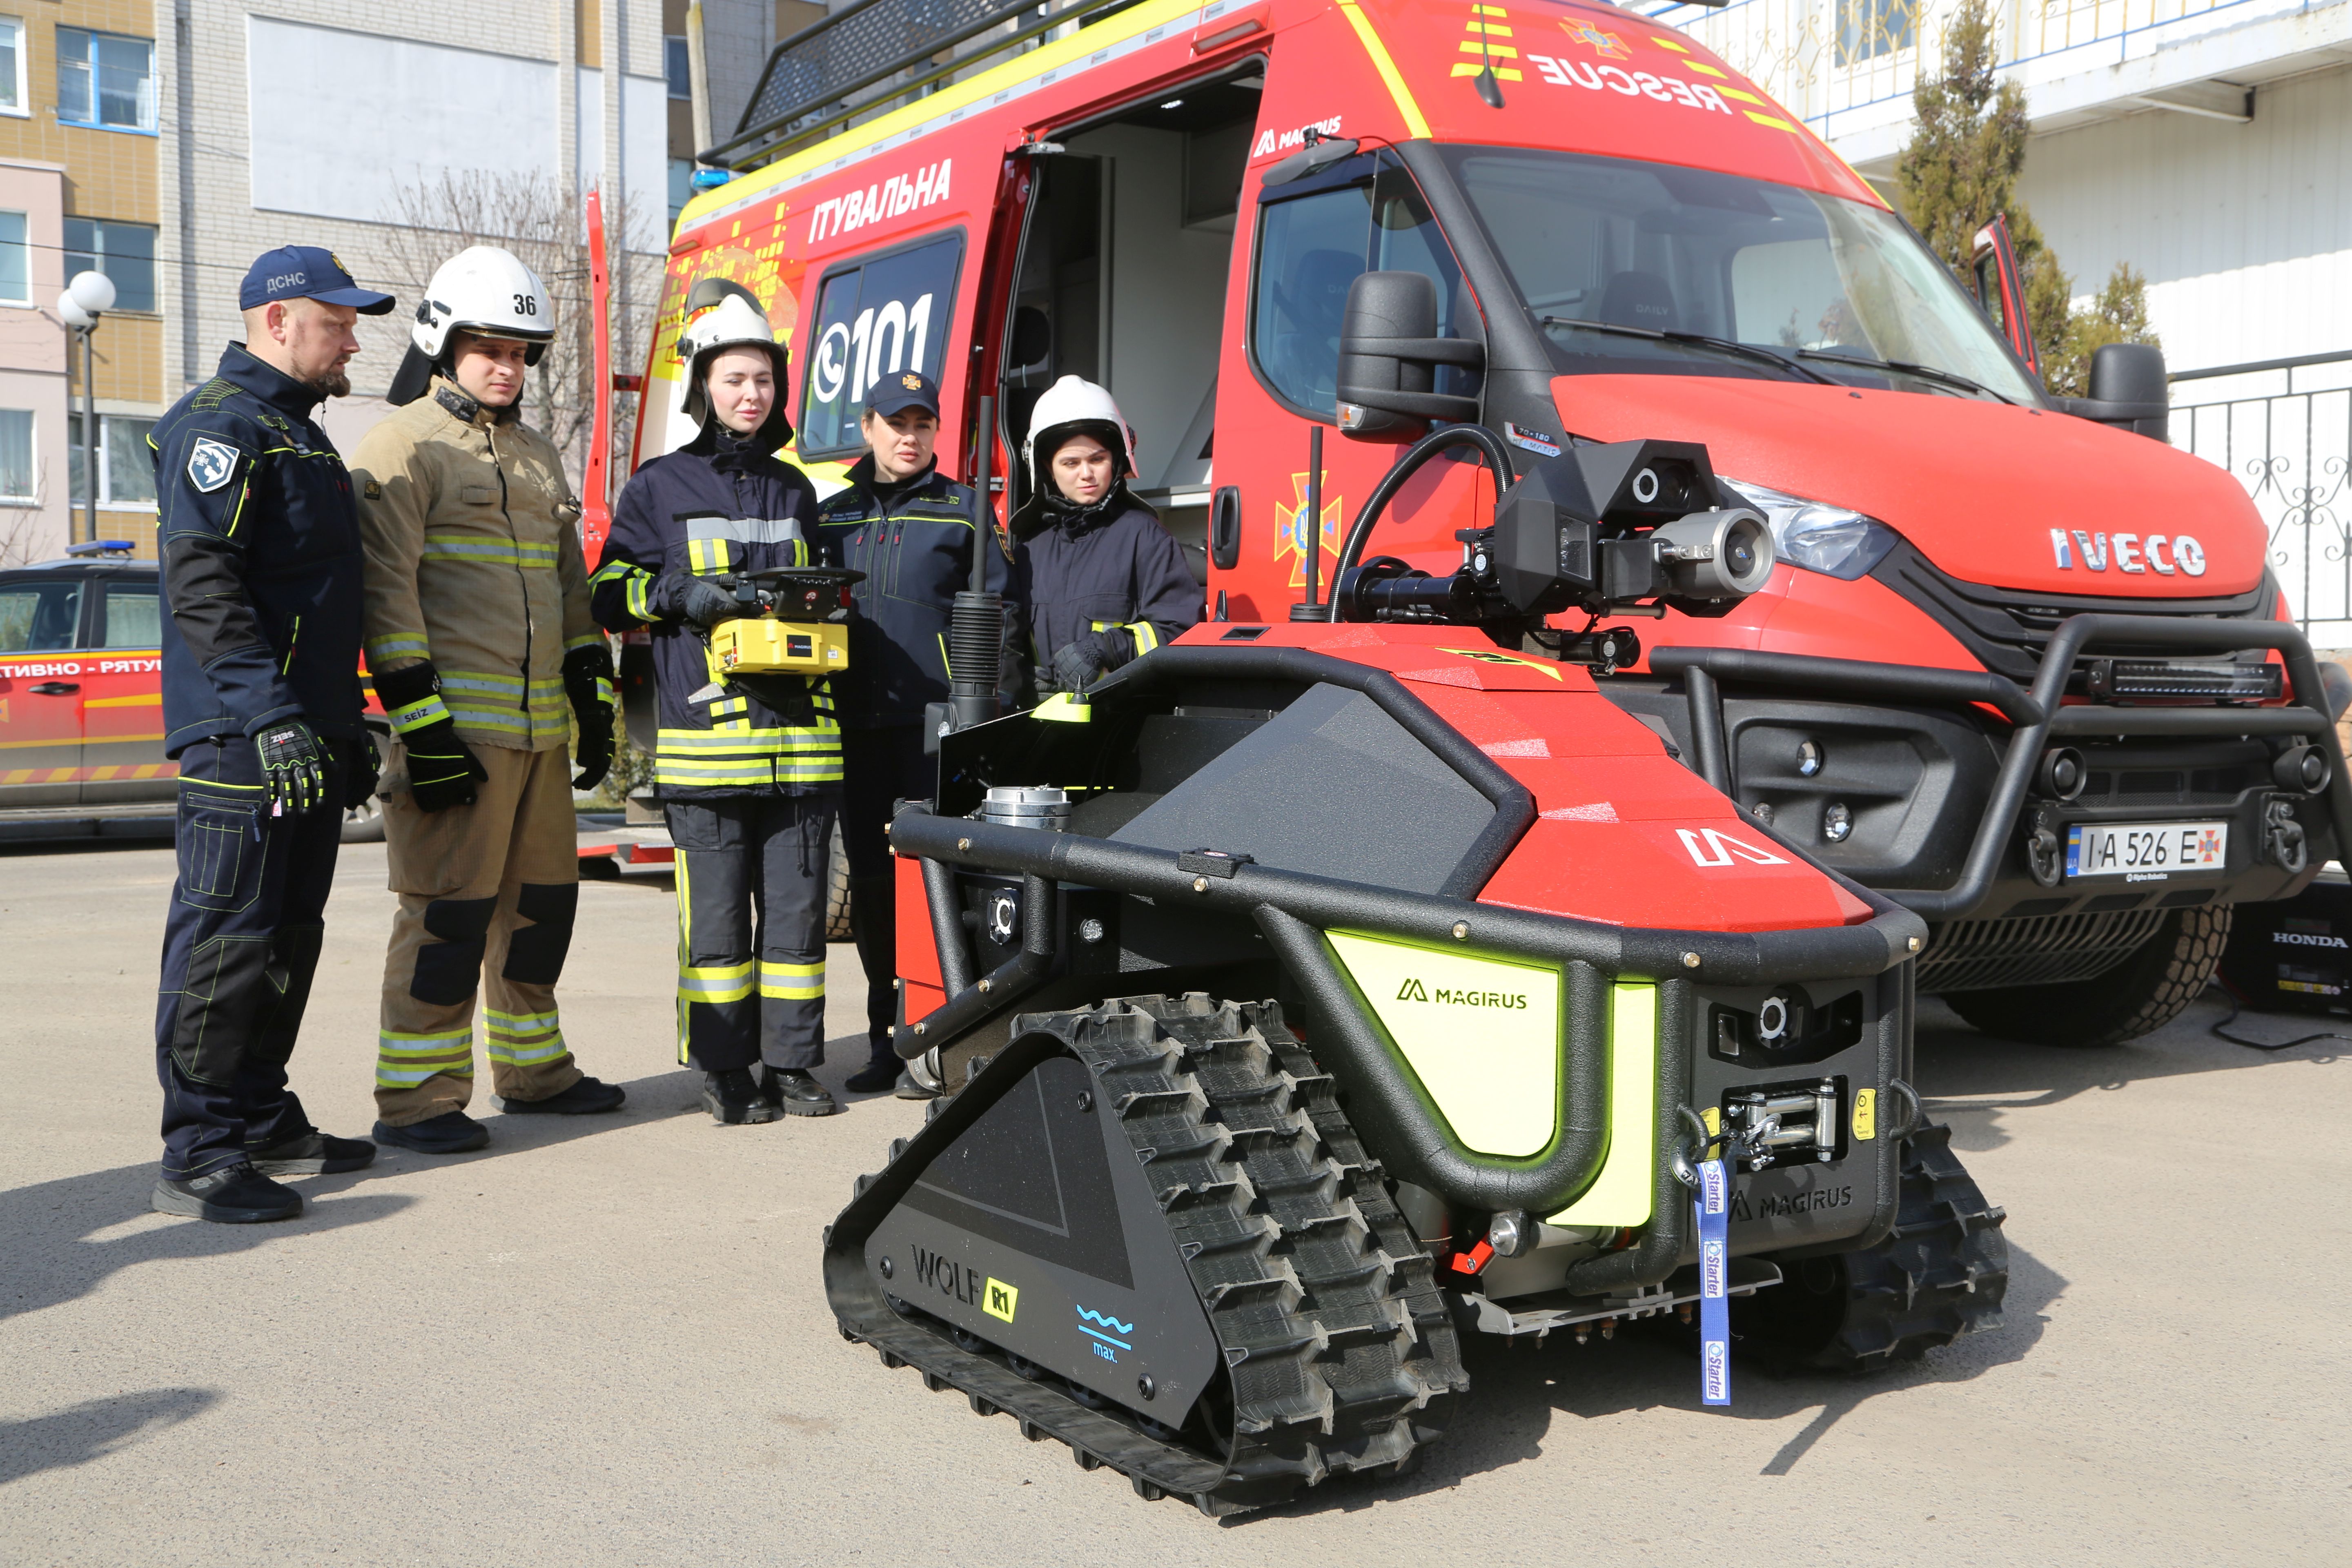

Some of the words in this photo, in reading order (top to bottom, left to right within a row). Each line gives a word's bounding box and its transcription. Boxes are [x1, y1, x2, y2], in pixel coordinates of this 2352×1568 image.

[808, 158, 952, 245] ІТУВАЛЬНА
[267, 272, 305, 294] ДСНС
[513, 294, 537, 316] 36
[1636, 304, 1669, 315] DAILY
[851, 292, 933, 403] 101
[2050, 528, 2206, 577] IVECO
[404, 707, 429, 723] SEIZ
[270, 731, 295, 744] SEIZ
[2087, 833, 2117, 868] IA
[2125, 831, 2167, 866] 526
[2180, 830, 2198, 864] E
[2067, 858, 2078, 869] UA
[2273, 932, 2349, 949] HONDA
[1436, 989, 1527, 1009] MAGIRUS
[1708, 1173, 1720, 1212] Starter
[1760, 1186, 1852, 1219] MAGIRUS
[911, 1243, 979, 1306] WOLF
[991, 1285, 1009, 1315] R1
[1708, 1256, 1719, 1296] Starter
[1093, 1341, 1118, 1364] max.
[1710, 1356, 1722, 1398] Starter
